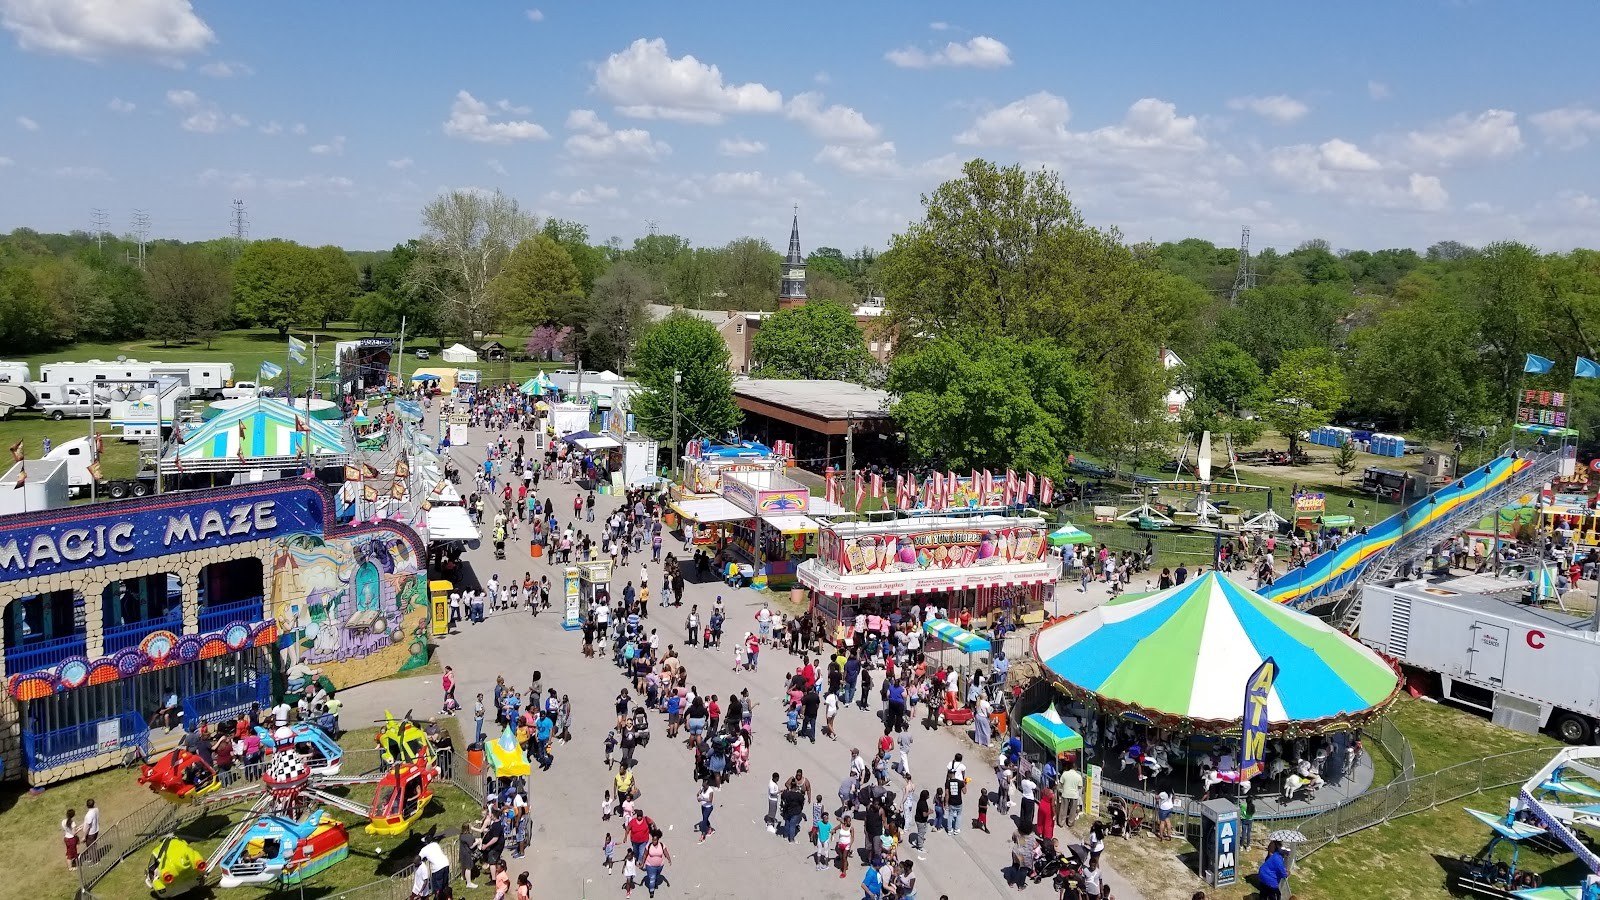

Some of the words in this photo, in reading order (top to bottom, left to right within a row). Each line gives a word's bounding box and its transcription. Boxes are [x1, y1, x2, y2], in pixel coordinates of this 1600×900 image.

[1525, 389, 1565, 406] FUN
[1519, 407, 1566, 426] SLIDE
[1560, 474, 1589, 484] BUS
[0, 521, 135, 570] MAGIC
[164, 500, 277, 546] MAZE
[914, 534, 932, 545] YUM
[933, 533, 950, 544] YUM
[1526, 629, 1546, 650] C
[1245, 662, 1274, 761] ATM
[1218, 822, 1235, 869] ATM
